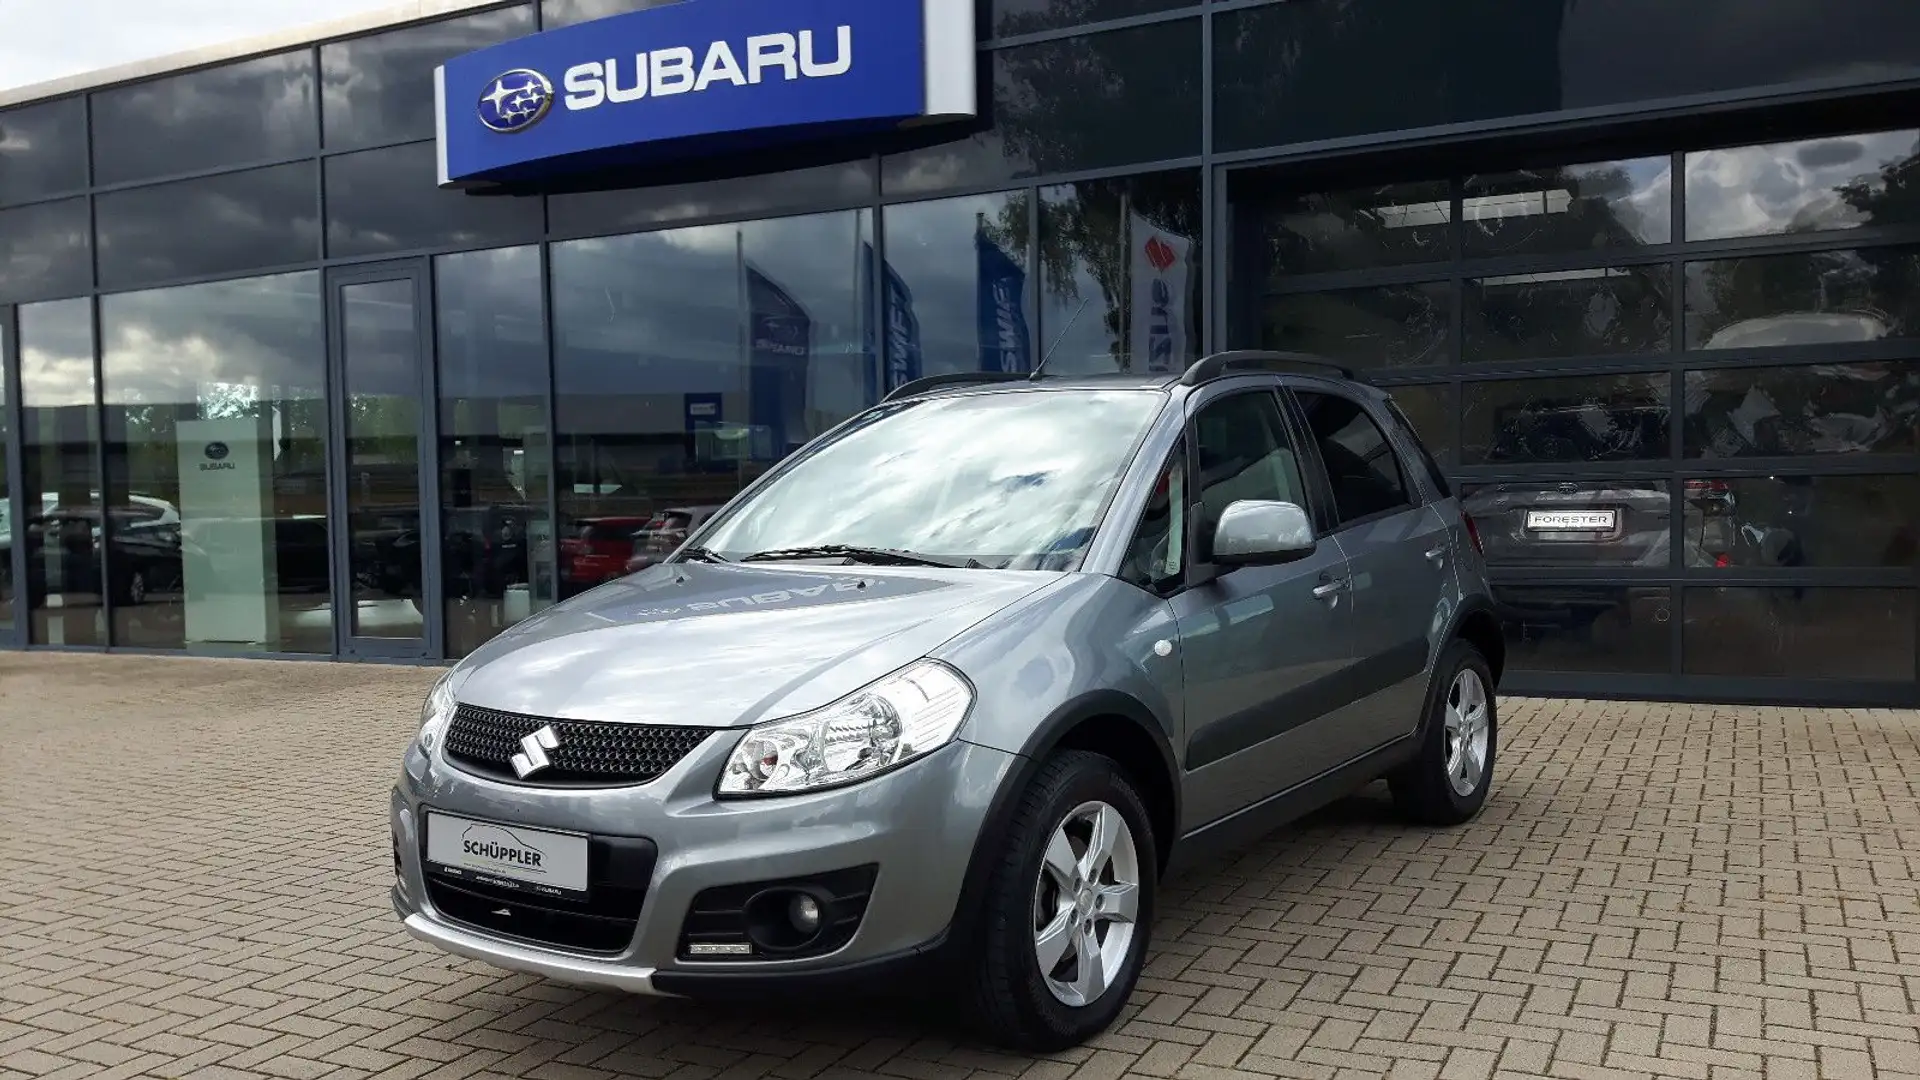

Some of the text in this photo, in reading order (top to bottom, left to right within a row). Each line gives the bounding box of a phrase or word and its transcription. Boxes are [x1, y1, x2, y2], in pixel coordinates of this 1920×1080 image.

[564, 25, 851, 111] SUBARU
[1534, 515, 1608, 524] FORESTER
[463, 839, 542, 867] SCHÜPPLER
